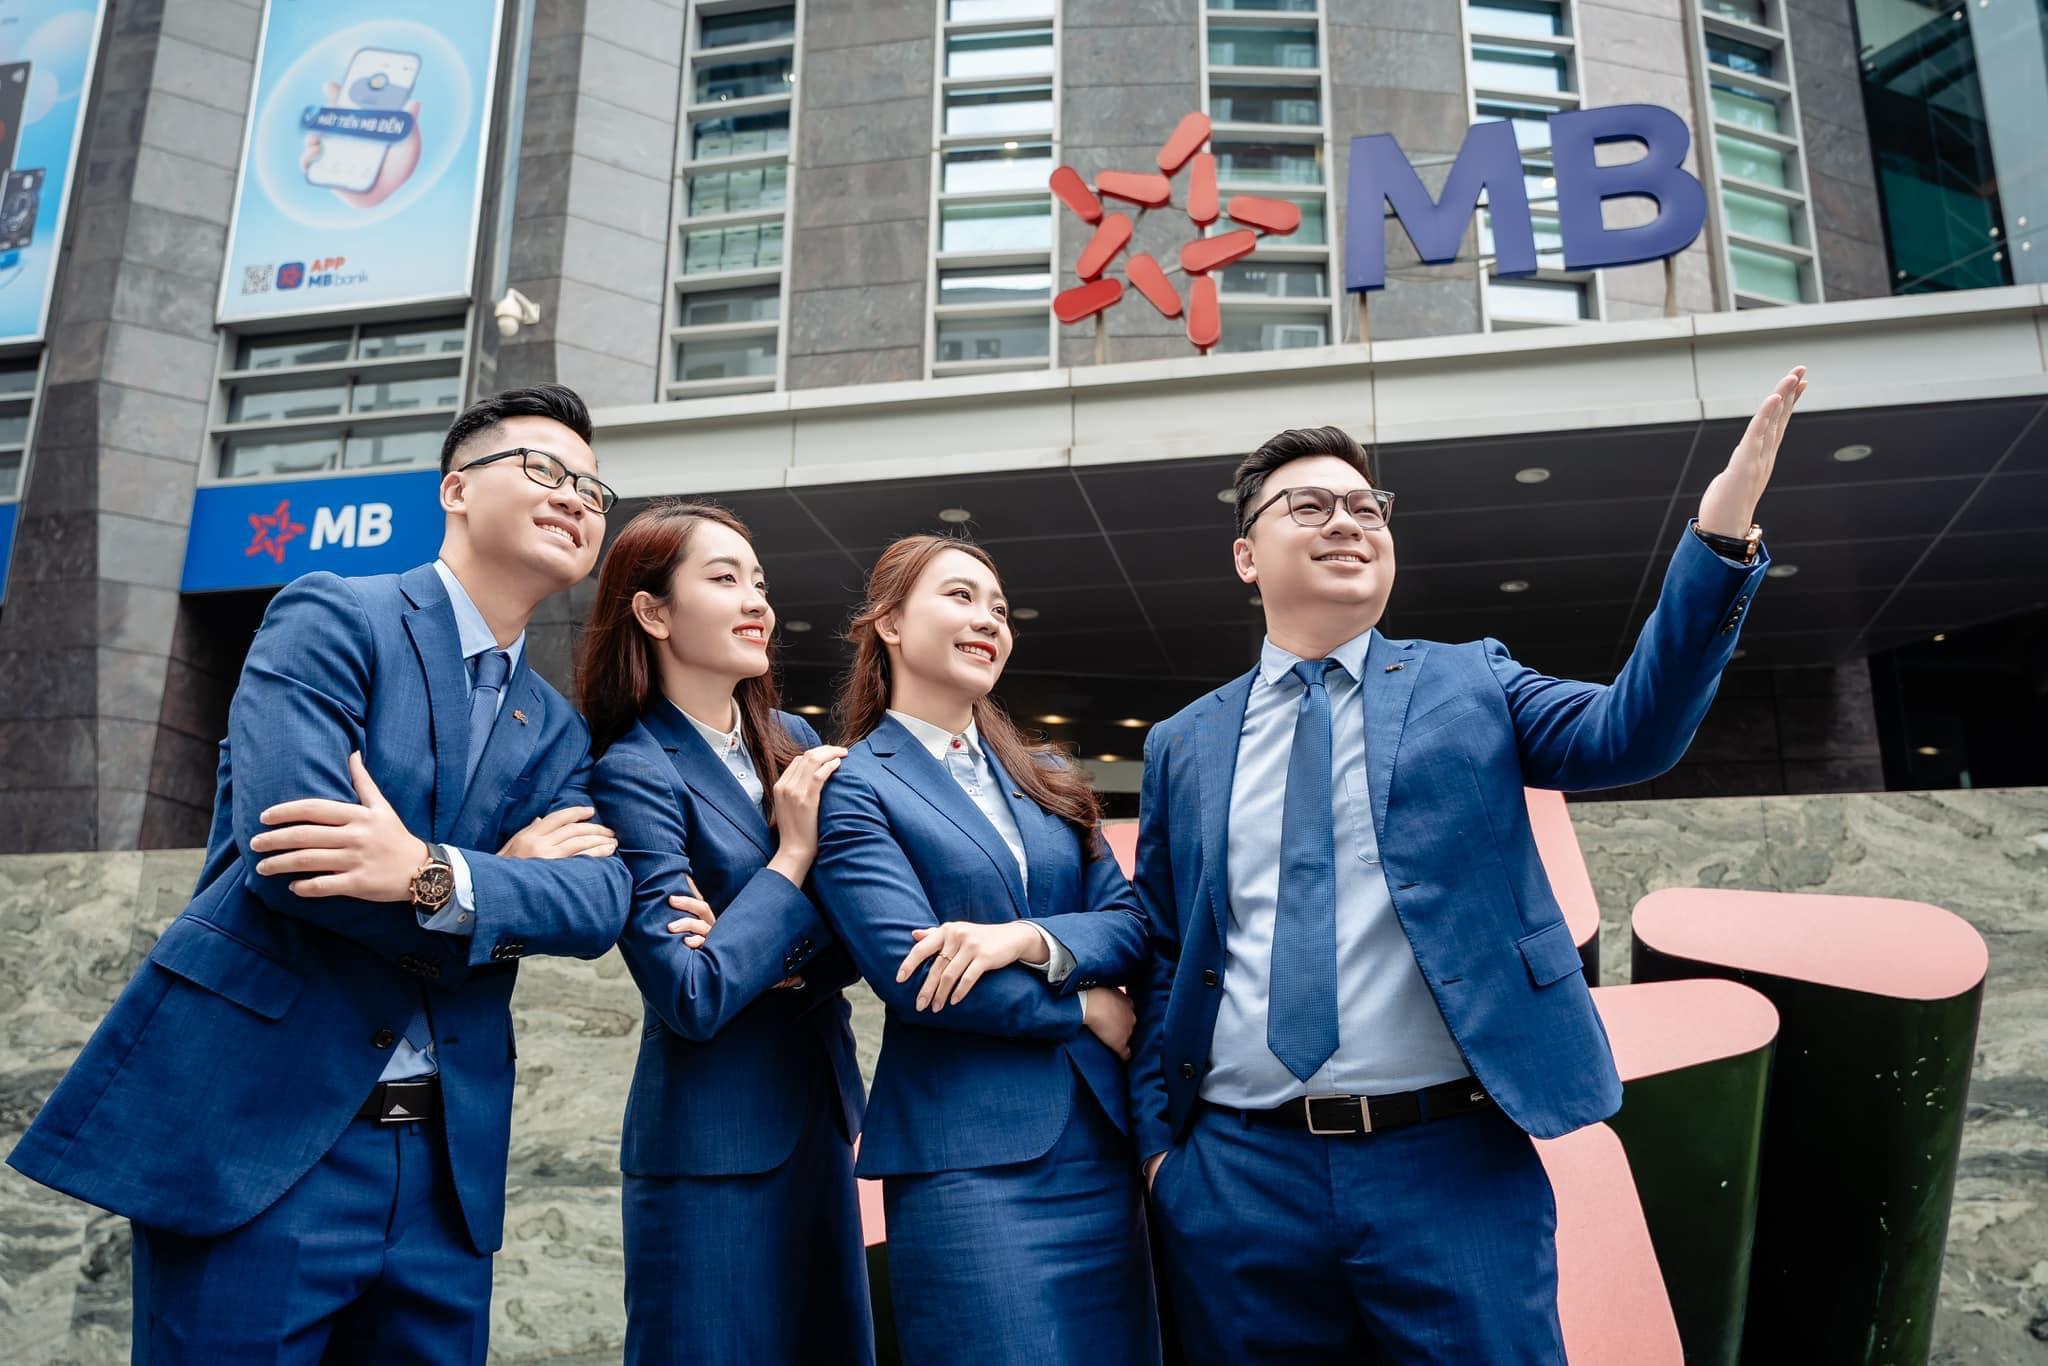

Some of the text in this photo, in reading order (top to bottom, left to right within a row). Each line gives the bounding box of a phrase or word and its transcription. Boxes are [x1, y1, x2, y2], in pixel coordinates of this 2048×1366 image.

[1346, 104, 1708, 293] MB
[311, 256, 346, 273] APP
[309, 502, 393, 550] MB
